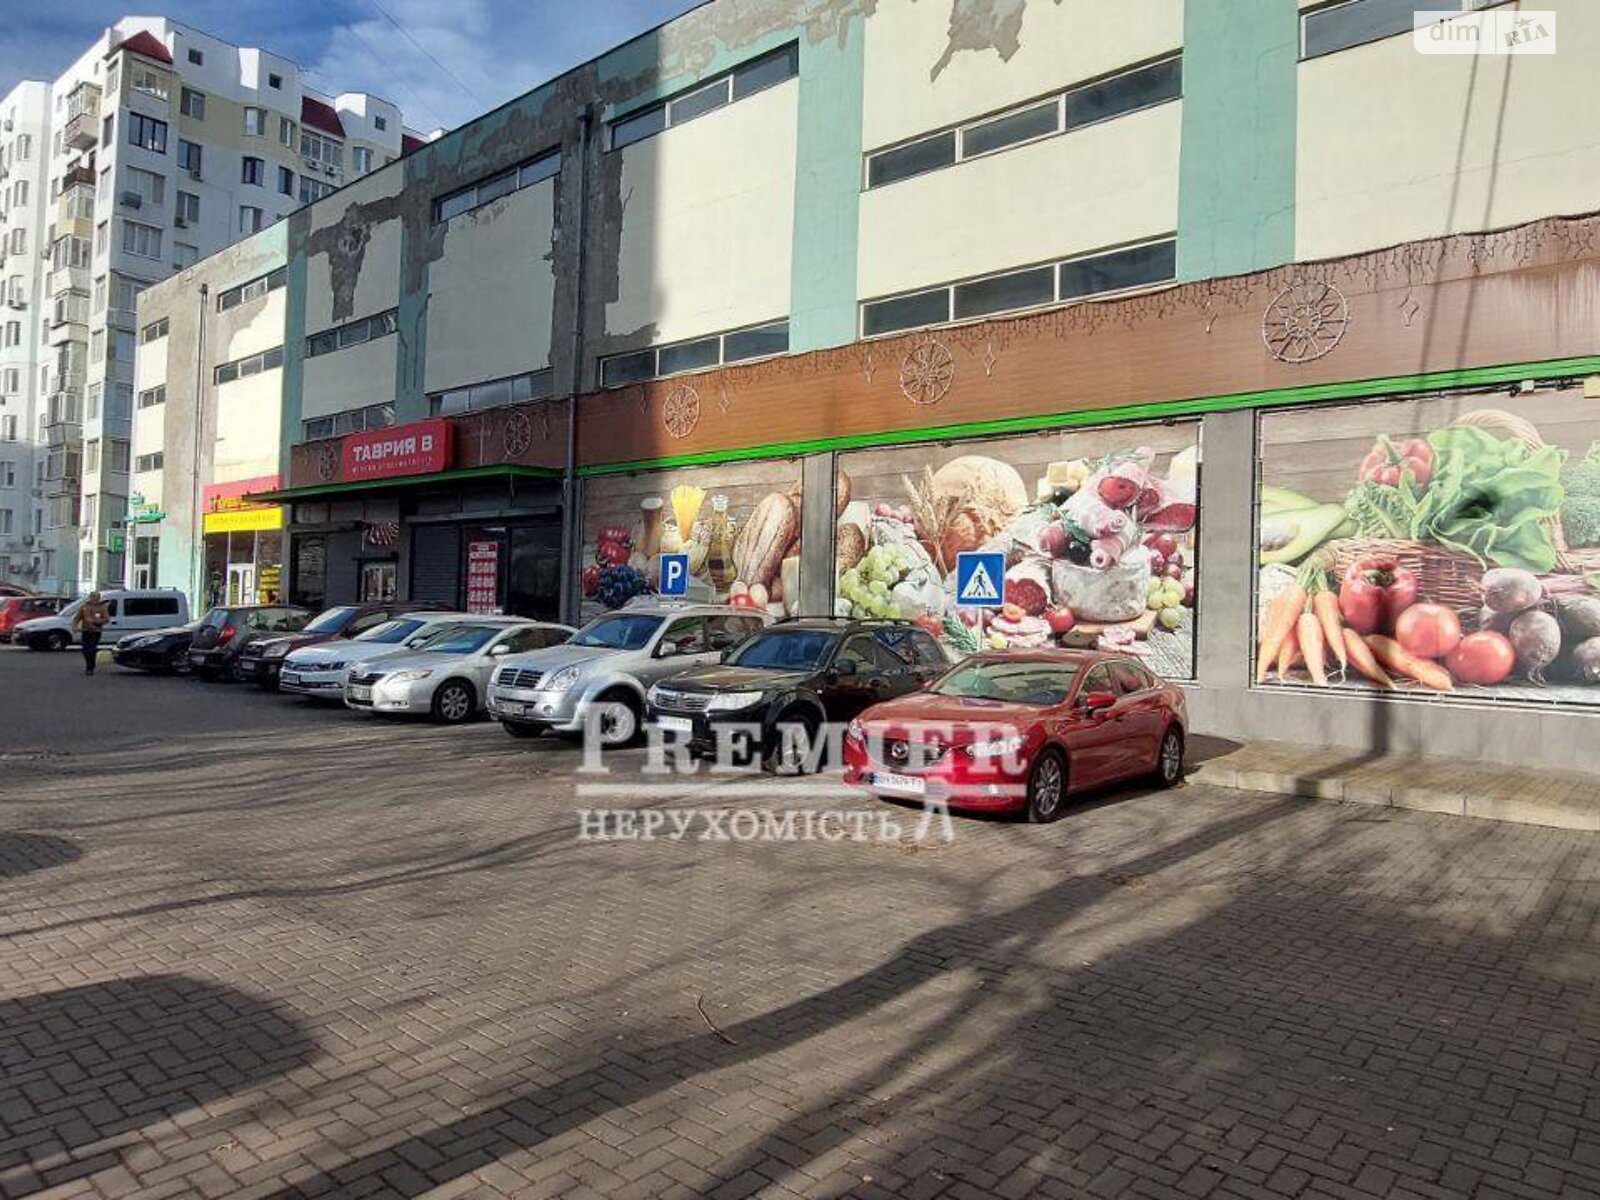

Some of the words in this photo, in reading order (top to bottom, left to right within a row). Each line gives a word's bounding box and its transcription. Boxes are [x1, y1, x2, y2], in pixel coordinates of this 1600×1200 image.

[353, 437, 416, 462] ТАВРИЯ
[422, 434, 433, 452] В
[667, 561, 682, 589] P
